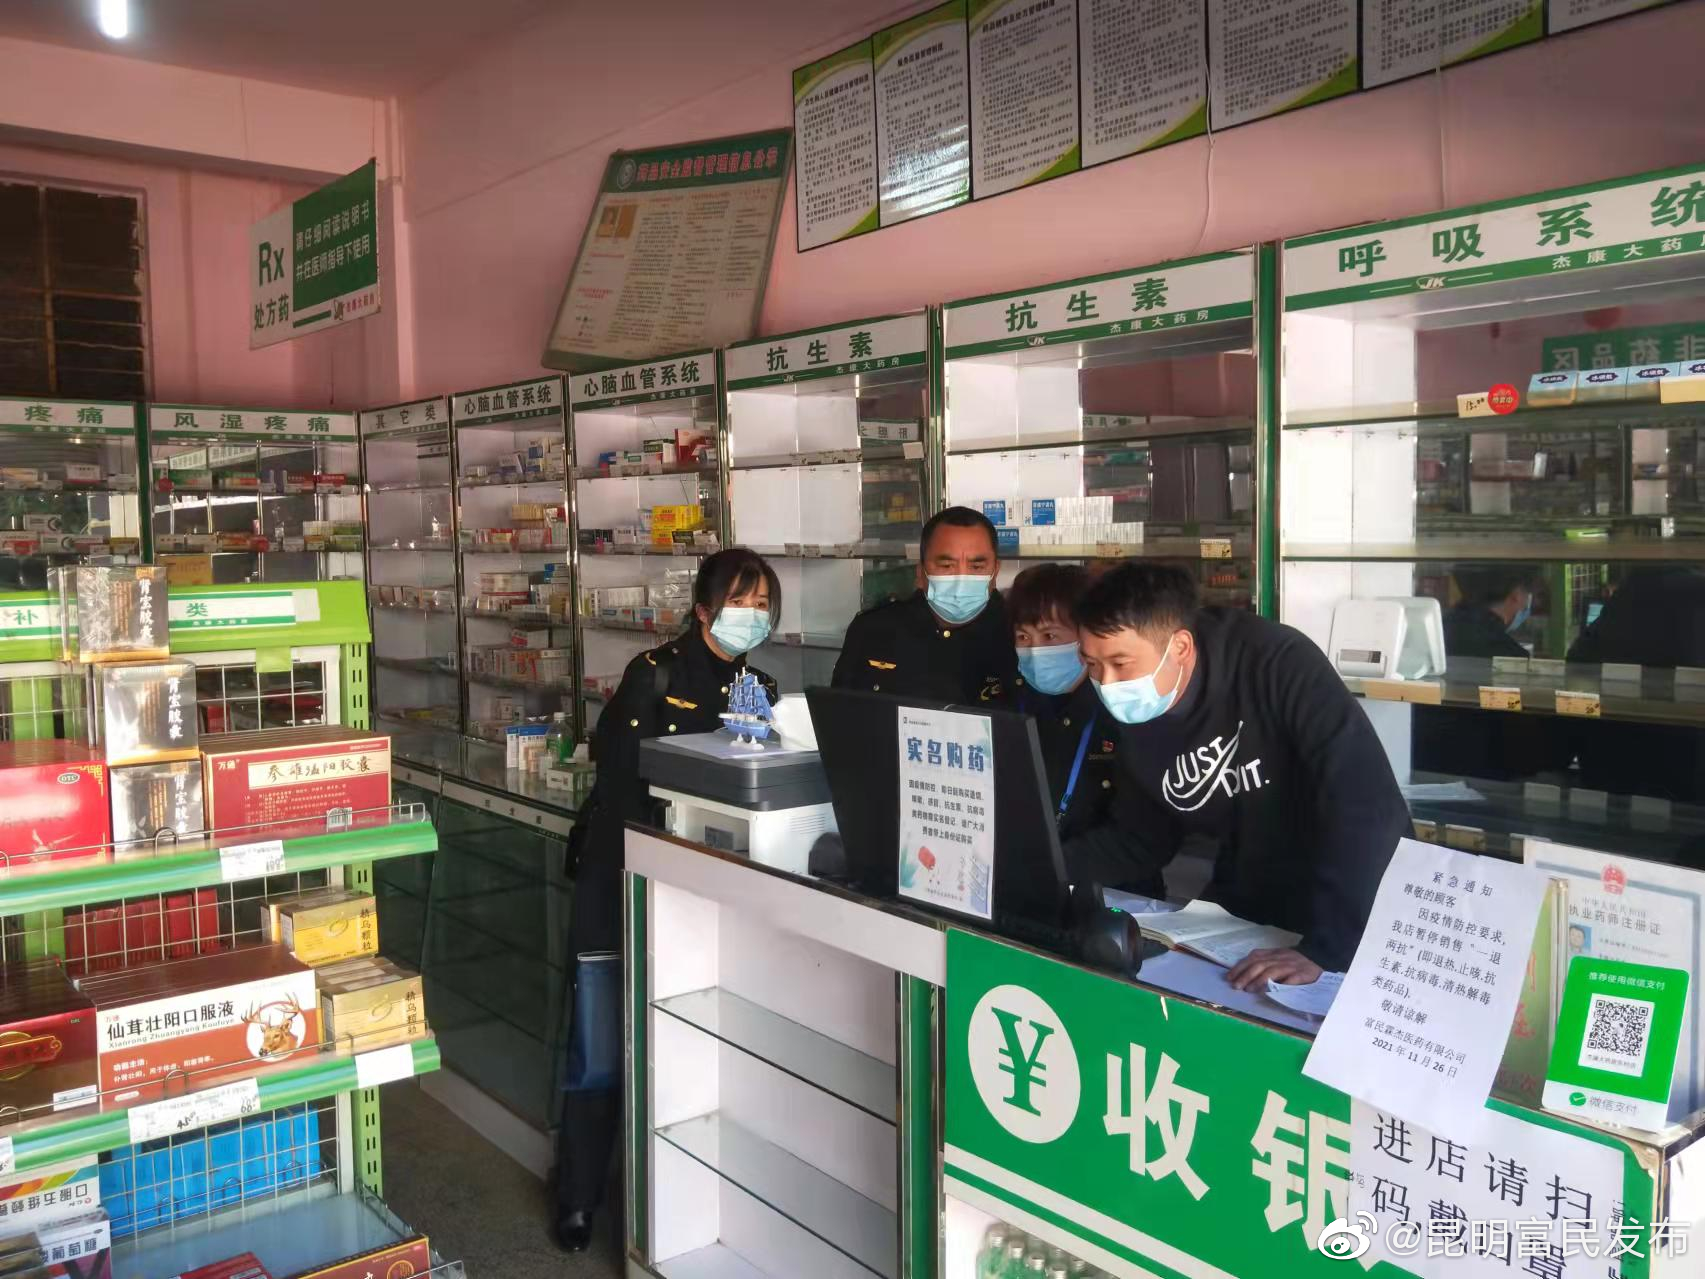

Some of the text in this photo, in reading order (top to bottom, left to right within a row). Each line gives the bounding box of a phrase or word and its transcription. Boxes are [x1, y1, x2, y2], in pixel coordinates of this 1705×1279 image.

[296, 201, 370, 250] 请仔细阅读说明书
[1338, 180, 1705, 278] 呼吸系统
[259, 241, 285, 287] Rx
[296, 234, 371, 282] 并在医师指导下使用
[254, 293, 290, 331] 处方药
[1005, 277, 1169, 332] 抗生素
[1109, 309, 1209, 335] 杰康大药房
[766, 331, 873, 372] 抗生素
[836, 356, 900, 375] 杰康大药房
[583, 360, 701, 398] 心脑血管系统
[24, 404, 105, 425] 疼痛
[463, 383, 553, 416] 心脑血管系统
[174, 412, 331, 432] 风湿疼痛
[375, 409, 437, 430] 其它类
[907, 736, 984, 772] 实名购药
[1403, 883, 1457, 908] 尊敬的顾客
[1432, 870, 1493, 898] 紧急通知
[1569, 903, 1662, 936] 执业药师注册证
[1588, 971, 1667, 992] 推荐使用微信支付
[107, 1000, 235, 1041] 仙茸壮阳口服液
[1380, 998, 1428, 1026] 敬请谅解
[1363, 1015, 1467, 1066] 富民霖杰医药有限公司
[1589, 1096, 1638, 1116] 微信支付
[1373, 1112, 1593, 1229] 进店请扫
